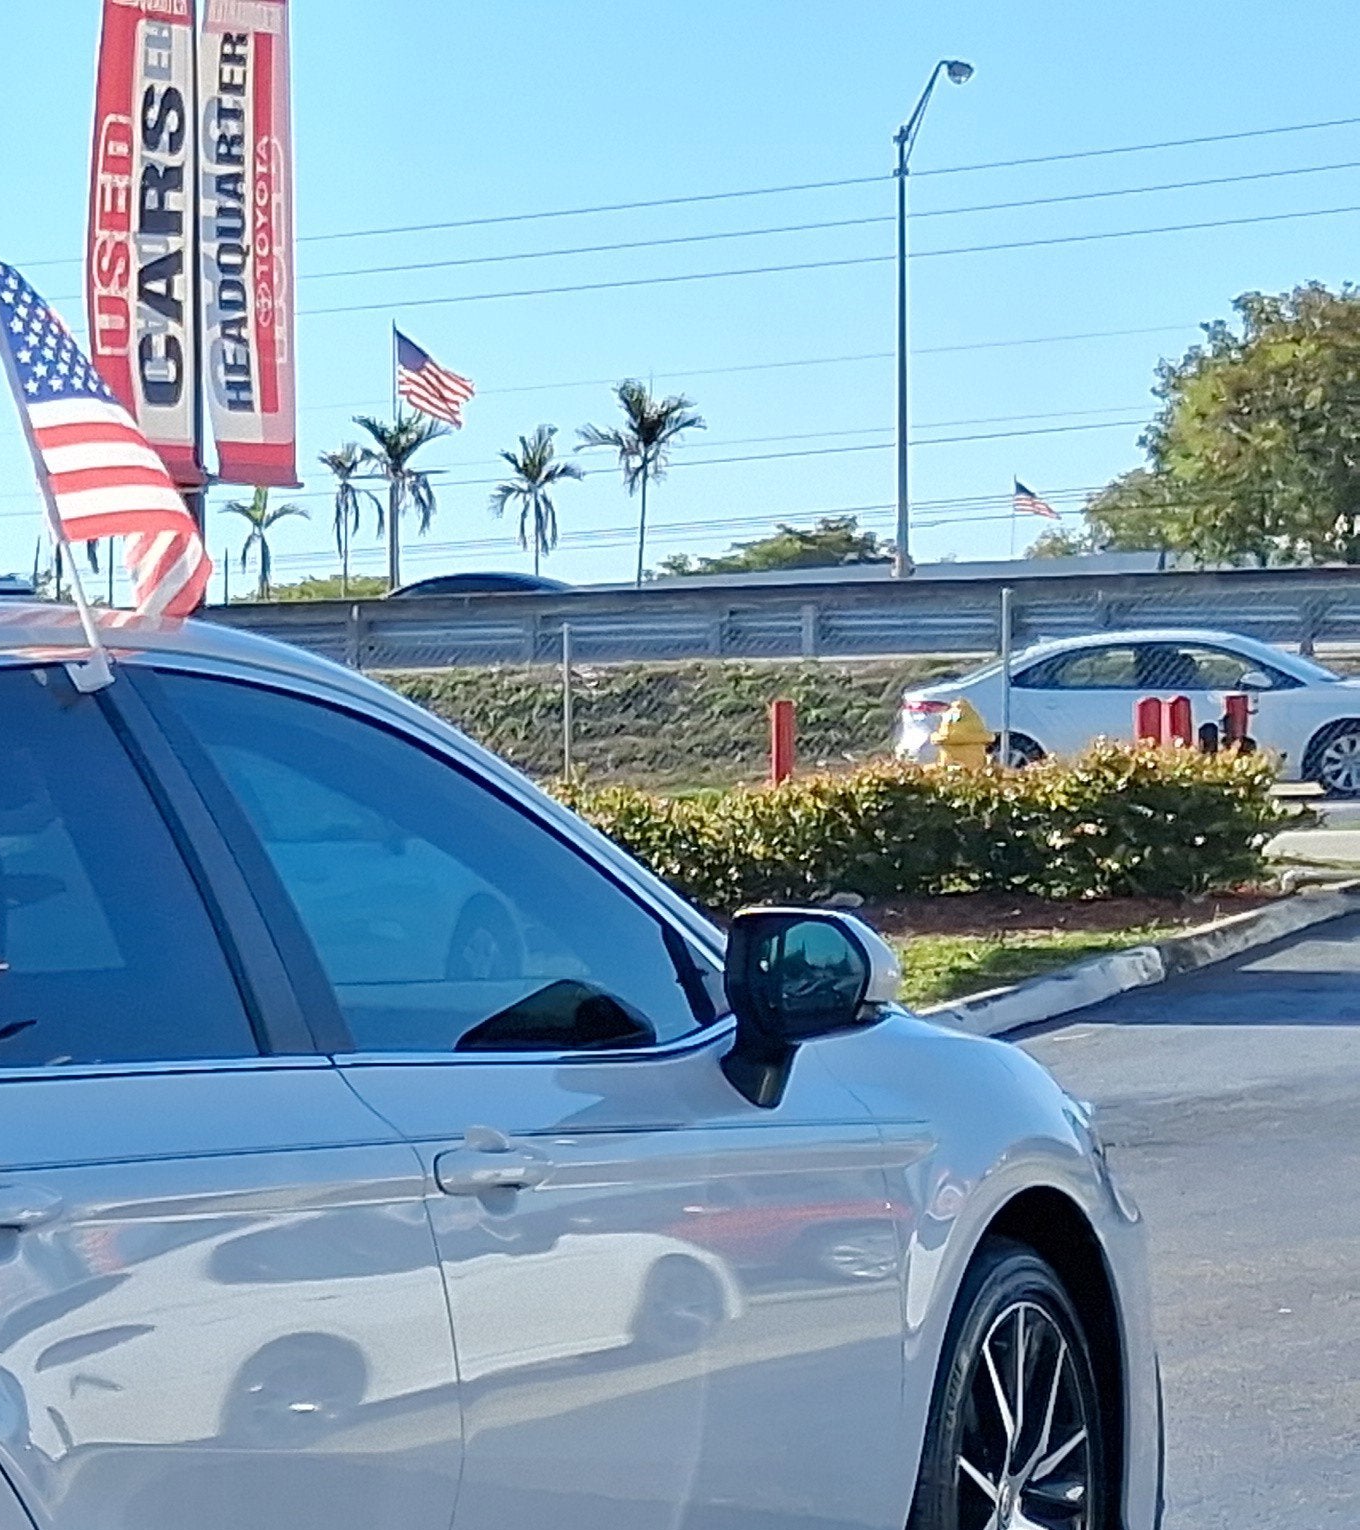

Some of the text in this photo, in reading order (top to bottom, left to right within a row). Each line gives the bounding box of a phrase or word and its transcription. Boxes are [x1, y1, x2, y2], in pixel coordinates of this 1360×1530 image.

[93, 113, 133, 356] USED
[138, 84, 185, 406] CARS
[216, 31, 255, 413] HEADQUARTER
[255, 135, 272, 288] TOYOTA
